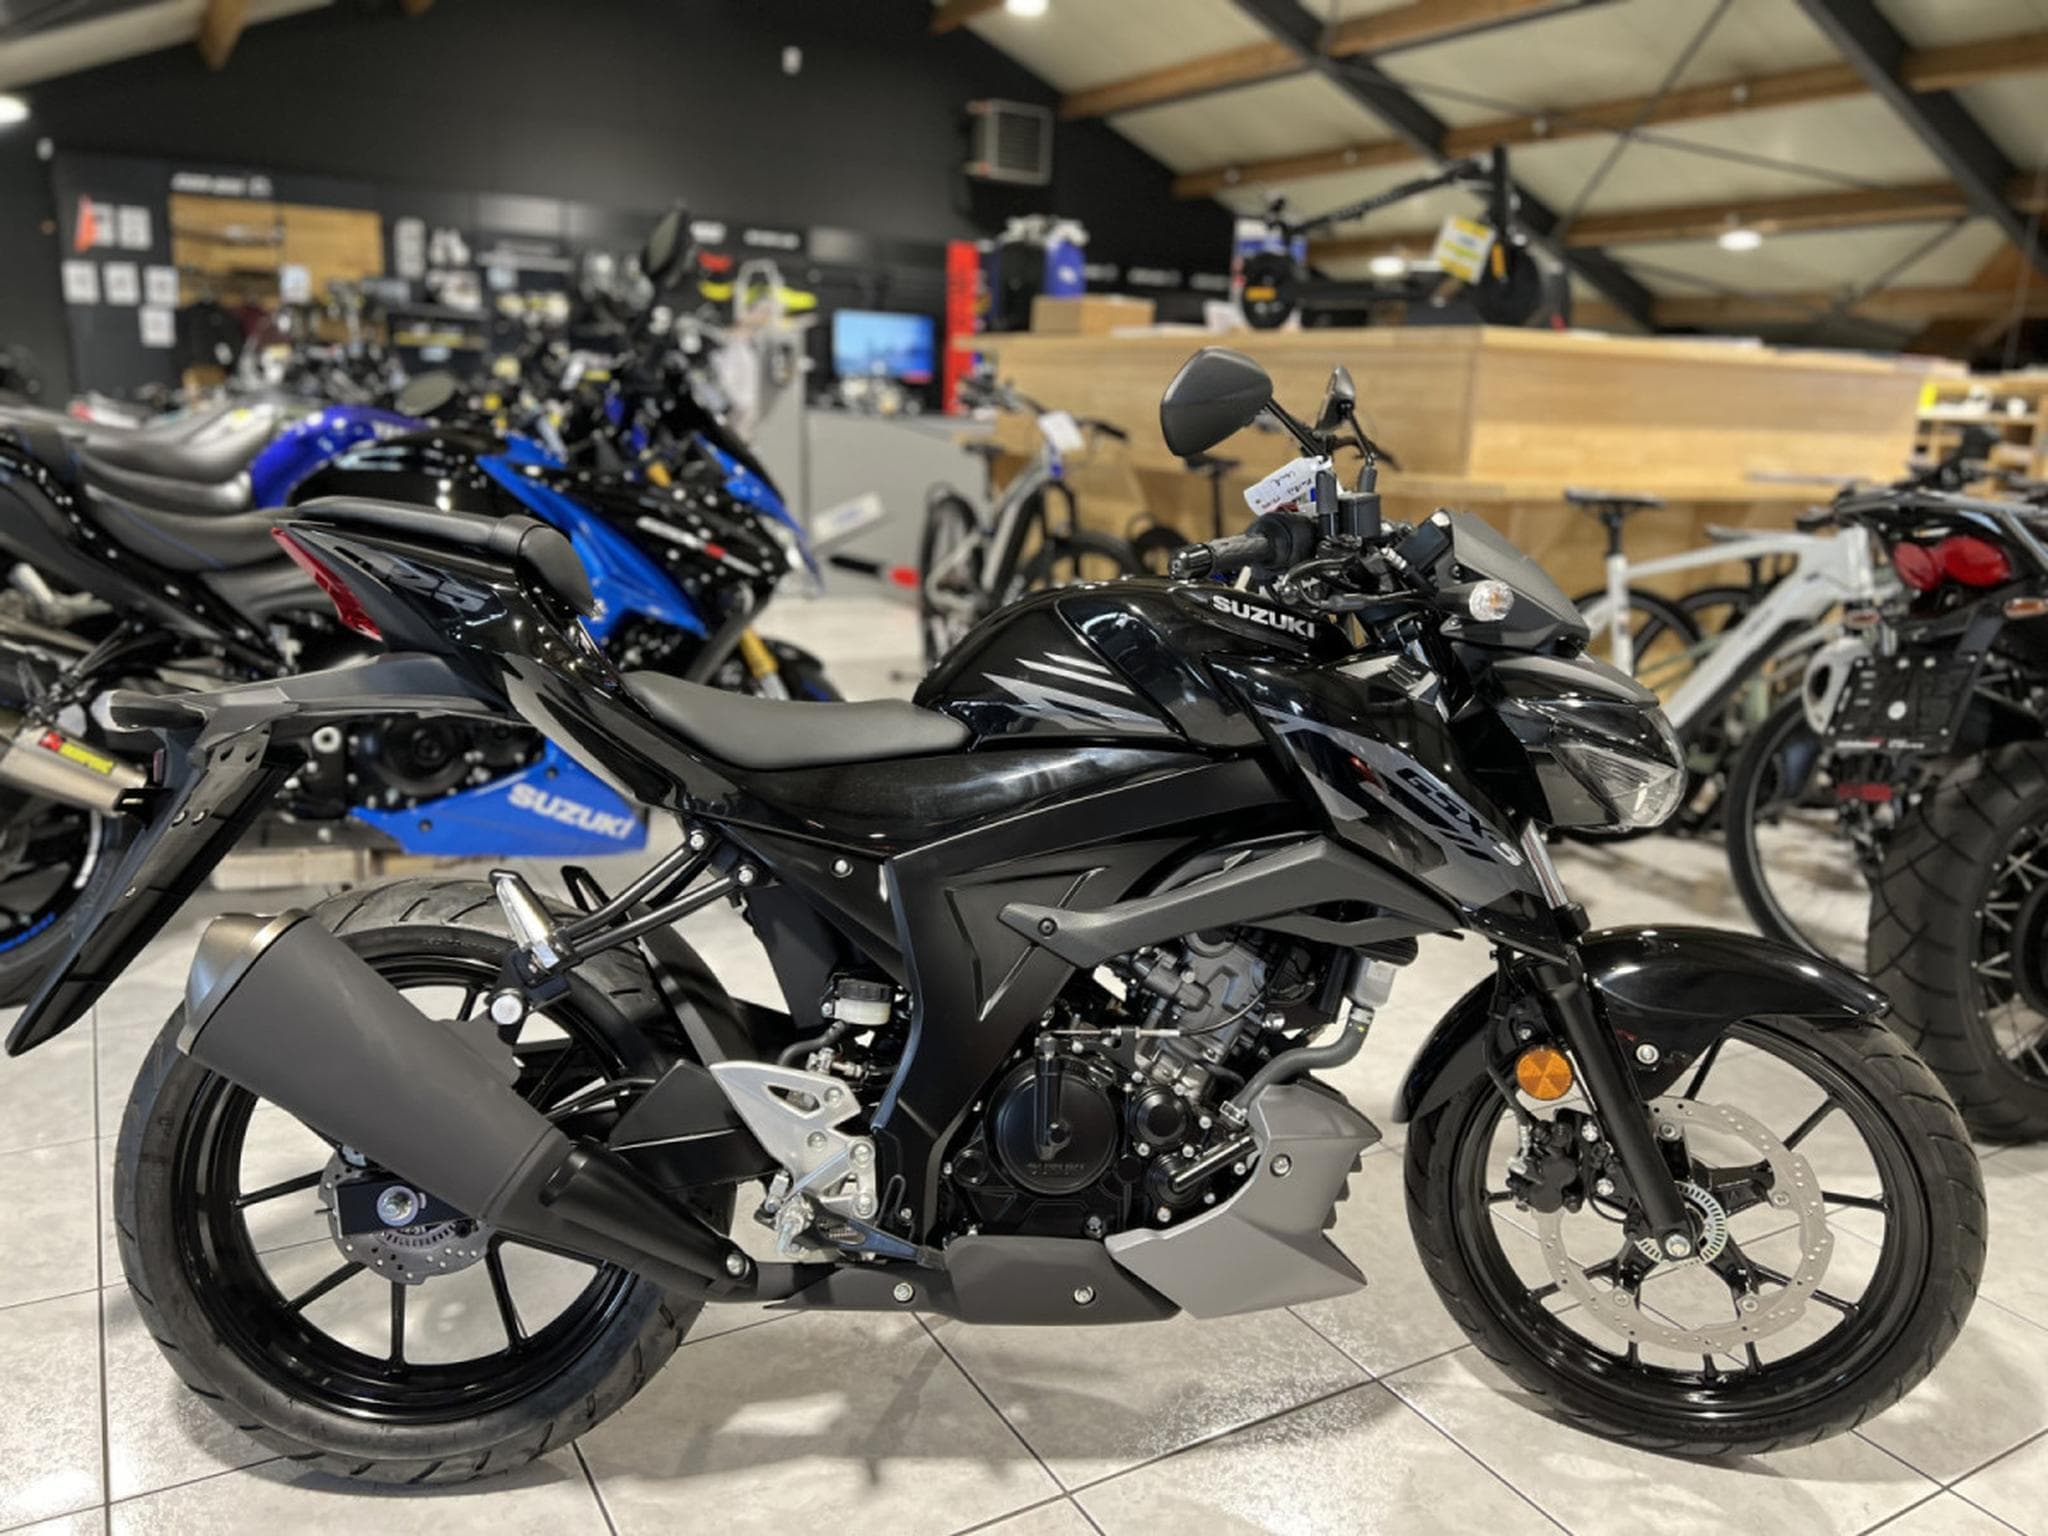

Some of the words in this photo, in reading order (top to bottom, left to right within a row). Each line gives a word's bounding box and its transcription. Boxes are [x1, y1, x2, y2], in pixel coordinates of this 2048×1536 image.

[1212, 595, 1315, 639] SUZUKI
[508, 783, 636, 840] SUZUKI
[1396, 768, 1524, 866] GSX-S
